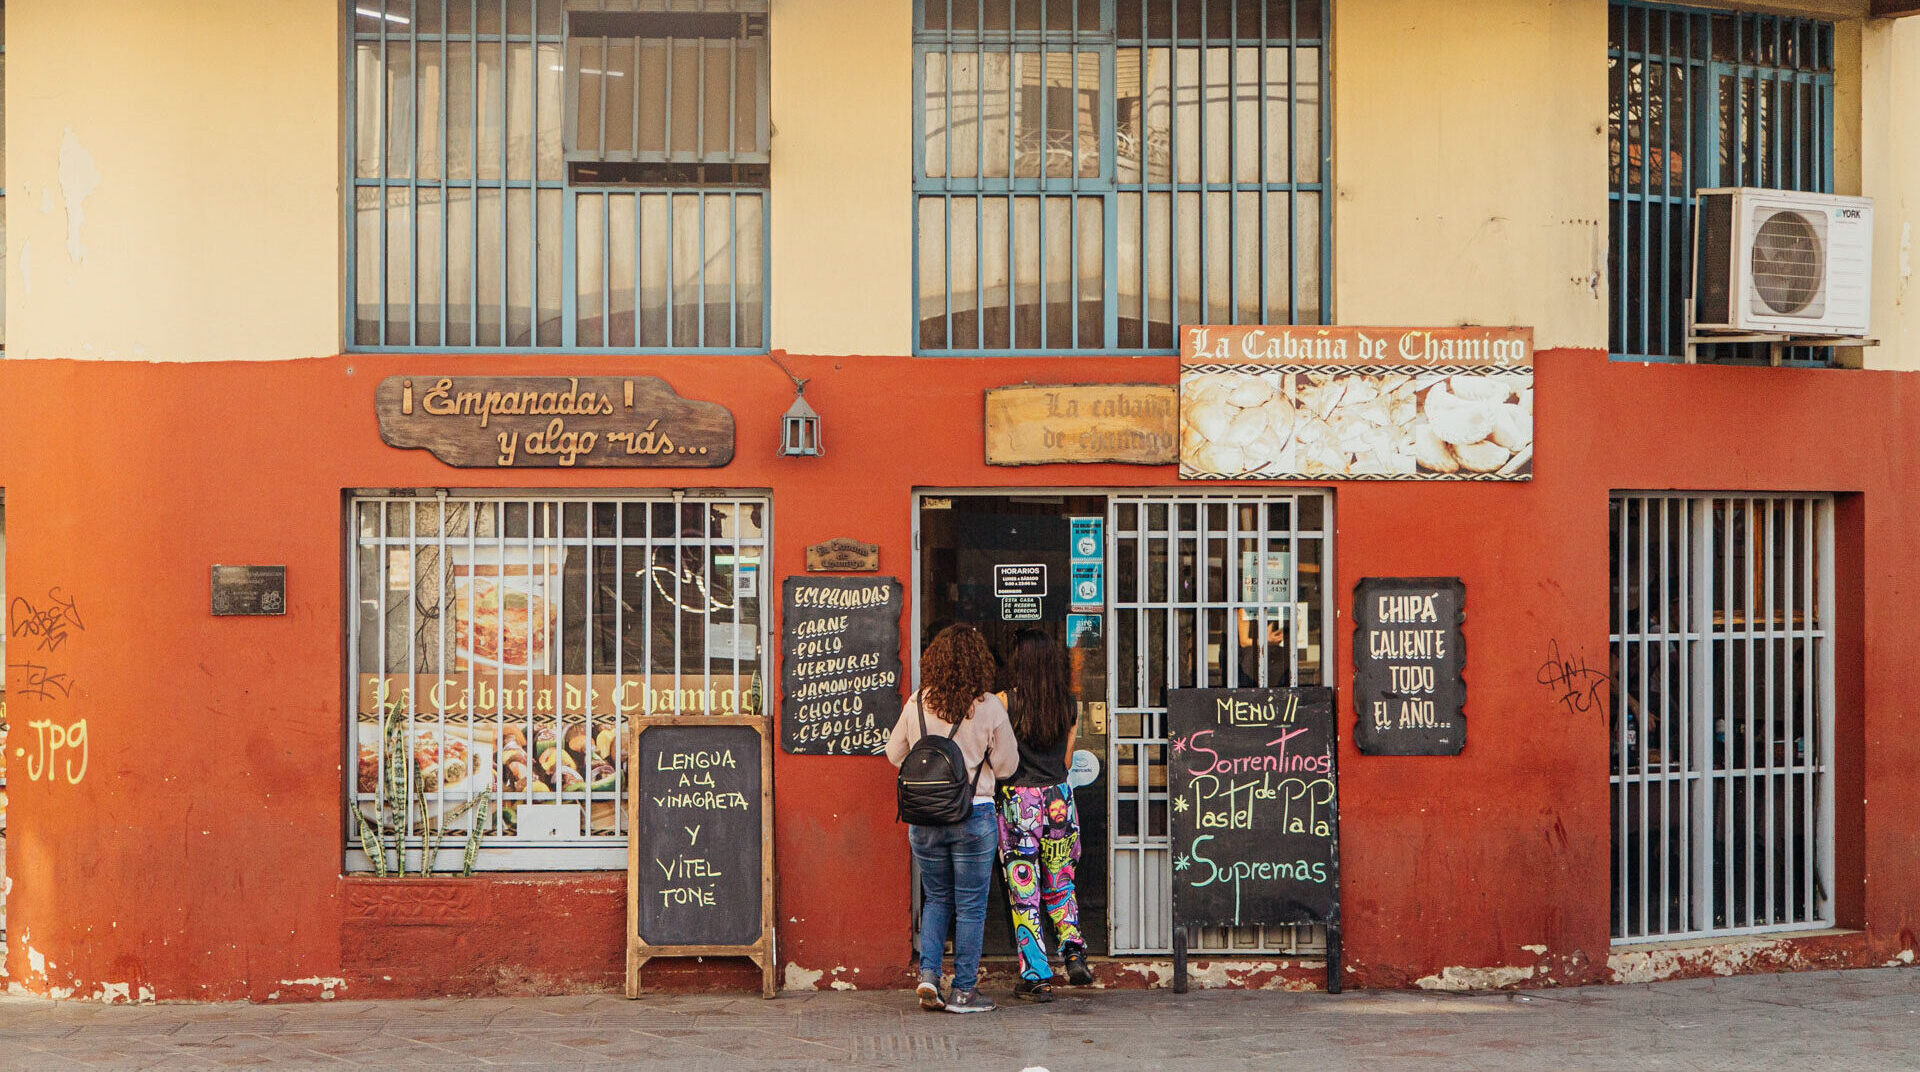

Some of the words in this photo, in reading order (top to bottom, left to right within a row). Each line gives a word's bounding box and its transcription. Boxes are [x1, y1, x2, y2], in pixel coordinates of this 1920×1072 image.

[1842, 209, 1861, 218] YORK
[1189, 329, 1230, 359] La
[1241, 330, 1348, 360] Cabaña
[1358, 332, 1387, 360] de
[1399, 330, 1525, 366] Chamigo
[422, 377, 615, 428] Empanadas
[1043, 393, 1079, 418] La
[497, 431, 517, 466] y
[524, 417, 599, 466] algo
[607, 419, 708, 455] más...
[1042, 426, 1066, 449] de
[794, 584, 890, 608] EMPANADAS
[1378, 592, 1439, 622] CHIPÁ
[797, 615, 848, 637] CARNE
[797, 636, 842, 658] POLLO
[1370, 629, 1446, 658] CALIENTE
[797, 652, 880, 678] VERDURAS
[853, 671, 895, 692] QUESO
[1388, 665, 1435, 692] TODO
[368, 677, 416, 710] La
[429, 679, 553, 710] Cabaña
[565, 682, 599, 711] de
[799, 696, 863, 721] CHOCLO
[1216, 696, 1276, 724] MENÚ
[1373, 701, 1392, 727] EL
[800, 713, 875, 740] CEBOLLA
[827, 739, 836, 753] Y
[841, 727, 891, 752] QUESO
[1188, 727, 1331, 776] Sorrentinos
[657, 749, 736, 771] LENGUA
[653, 788, 749, 810] VINAGRETA
[1189, 775, 1260, 830] Pastel
[1255, 771, 1277, 800] de
[684, 824, 701, 846] Y
[1190, 835, 1327, 926] Supremas
[659, 884, 716, 908] TONÉ
